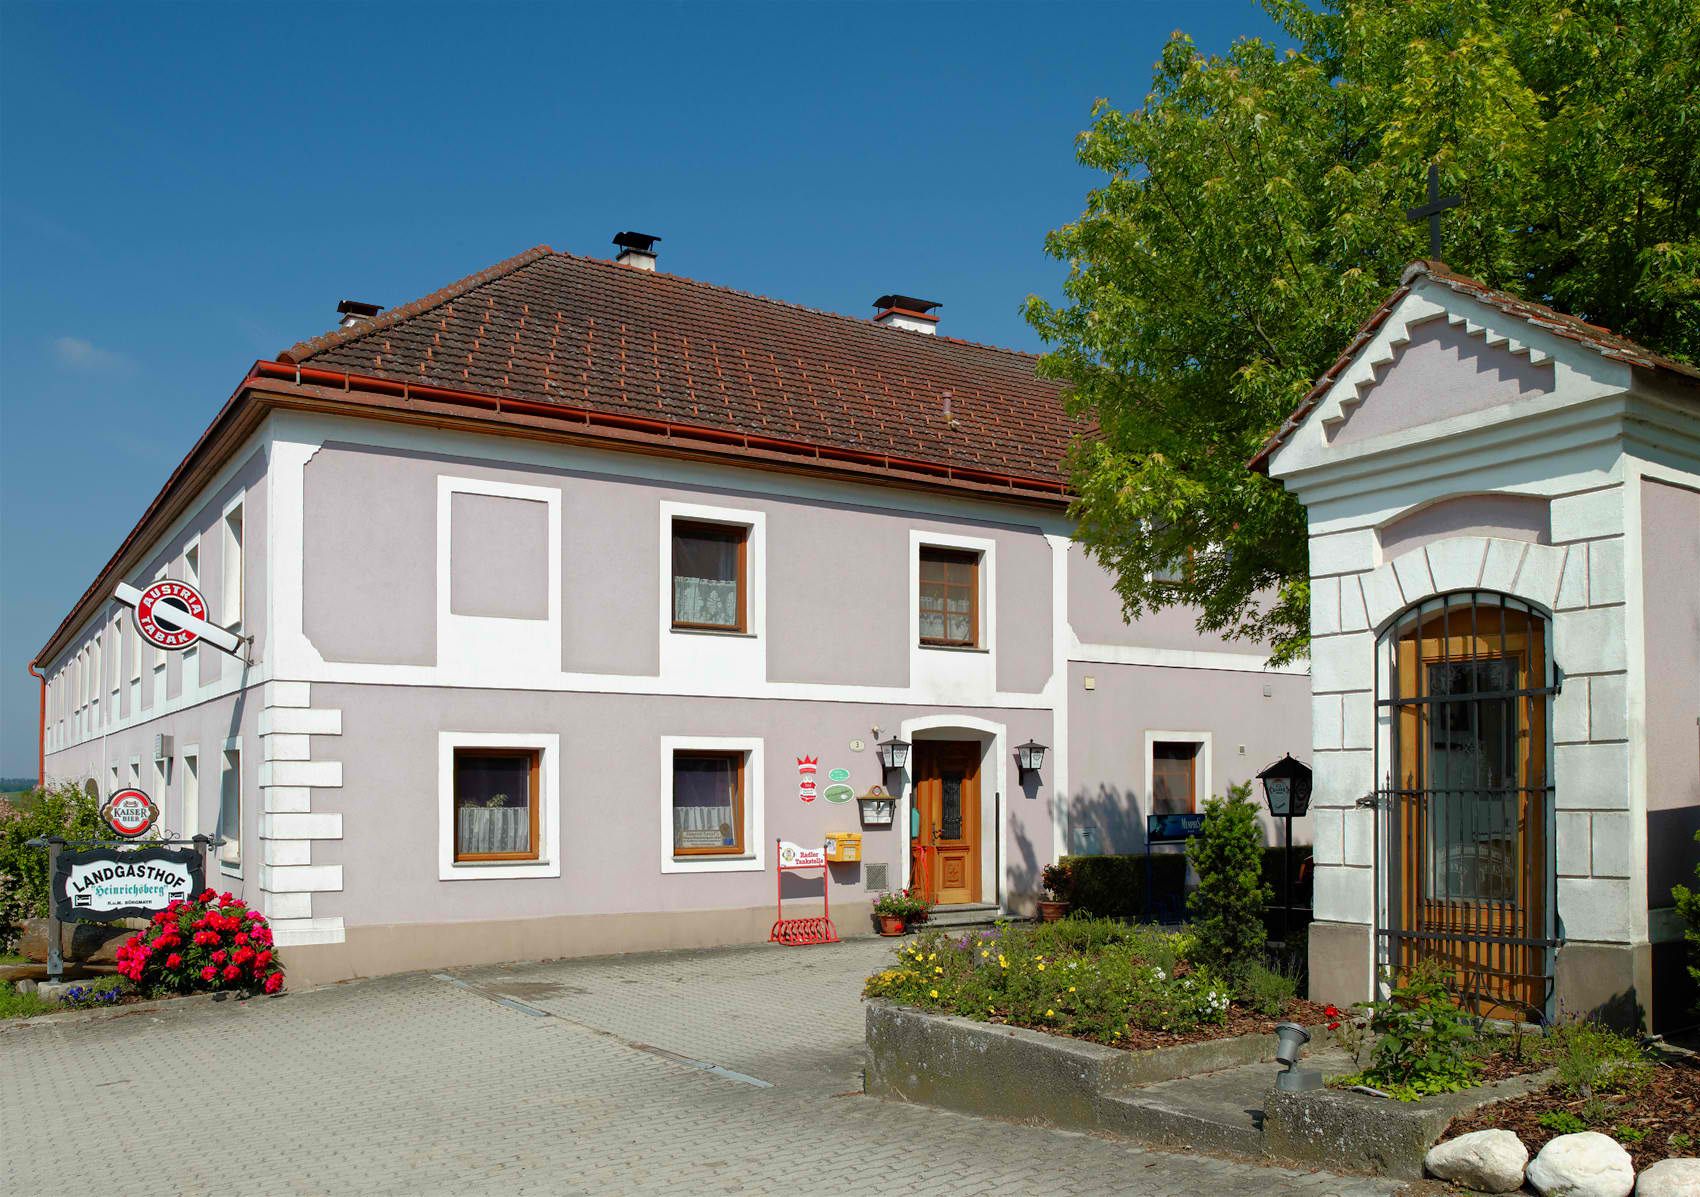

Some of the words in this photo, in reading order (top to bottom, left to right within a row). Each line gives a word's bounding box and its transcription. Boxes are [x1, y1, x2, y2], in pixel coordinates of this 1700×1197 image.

[143, 585, 202, 614] AUSTRIA
[141, 616, 189, 644] TABAK
[114, 808, 147, 818] KAISER
[72, 864, 186, 893] LANDGASTHOF
